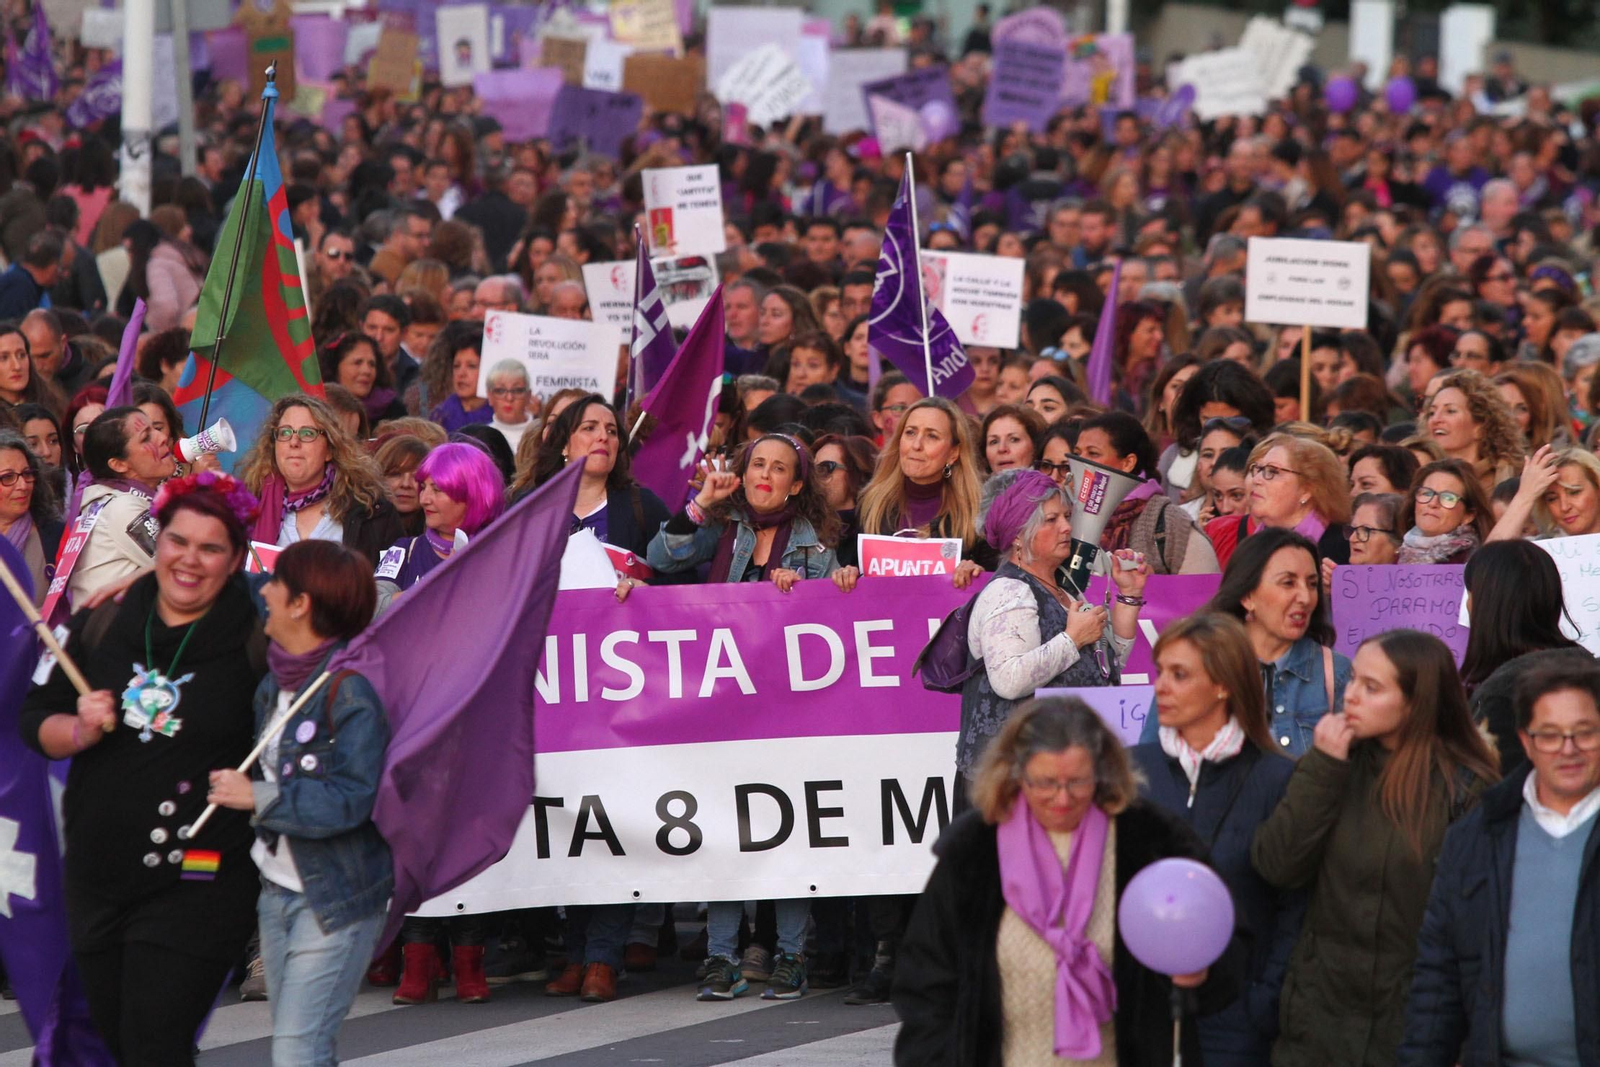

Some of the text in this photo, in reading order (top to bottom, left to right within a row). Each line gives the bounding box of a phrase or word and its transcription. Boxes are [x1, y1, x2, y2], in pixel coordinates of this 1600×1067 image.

[529, 327, 541, 336] LA
[535, 375, 598, 388] FEMINISTA
[868, 557, 947, 577] APUNTA
[784, 619, 900, 692] DE
[654, 790, 704, 856] 8
[734, 779, 850, 853] DE
